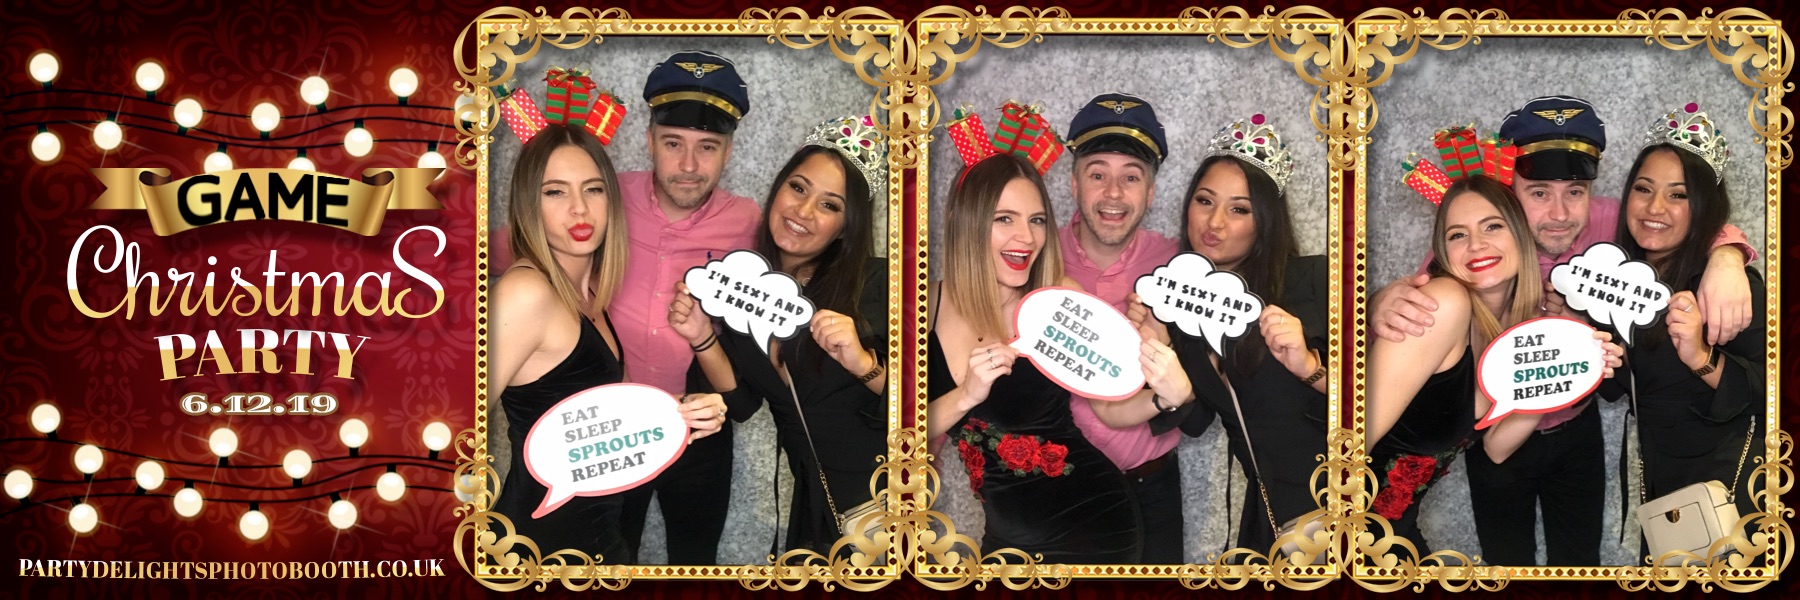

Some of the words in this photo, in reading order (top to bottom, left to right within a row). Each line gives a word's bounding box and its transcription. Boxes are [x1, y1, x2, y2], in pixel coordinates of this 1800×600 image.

[709, 270, 730, 286] I'M
[734, 281, 770, 302] SEXY
[774, 298, 805, 316] AND
[1156, 276, 1177, 291] I'M
[1181, 284, 1217, 303] SEXY
[1222, 297, 1253, 313] AND
[1571, 265, 1591, 279] I'M
[1595, 273, 1629, 291] SEXY
[1633, 285, 1662, 301] AND
[1577, 283, 1585, 293] I
[1588, 287, 1625, 307] KNOW
[1629, 301, 1646, 313] IT
[714, 289, 722, 299] I
[725, 293, 765, 318] KNOW
[769, 313, 787, 327] IT
[1060, 296, 1093, 321] EAT
[1164, 295, 1171, 305] I
[1175, 298, 1214, 319] KNOW
[1219, 313, 1236, 326] IT
[1052, 311, 1100, 343] SLEEP
[1513, 333, 1545, 348] EAT
[1033, 339, 1096, 381] REPEAT
[1043, 325, 1122, 378] SPROUTS
[1513, 348, 1560, 365] SLEEP
[1513, 361, 1589, 383] SPROUTS
[1513, 380, 1573, 401] REPEAT
[561, 405, 599, 426] EAT
[565, 418, 623, 443] SLEEP
[568, 426, 665, 463] SPROUTS
[571, 451, 646, 483] REPEAT
